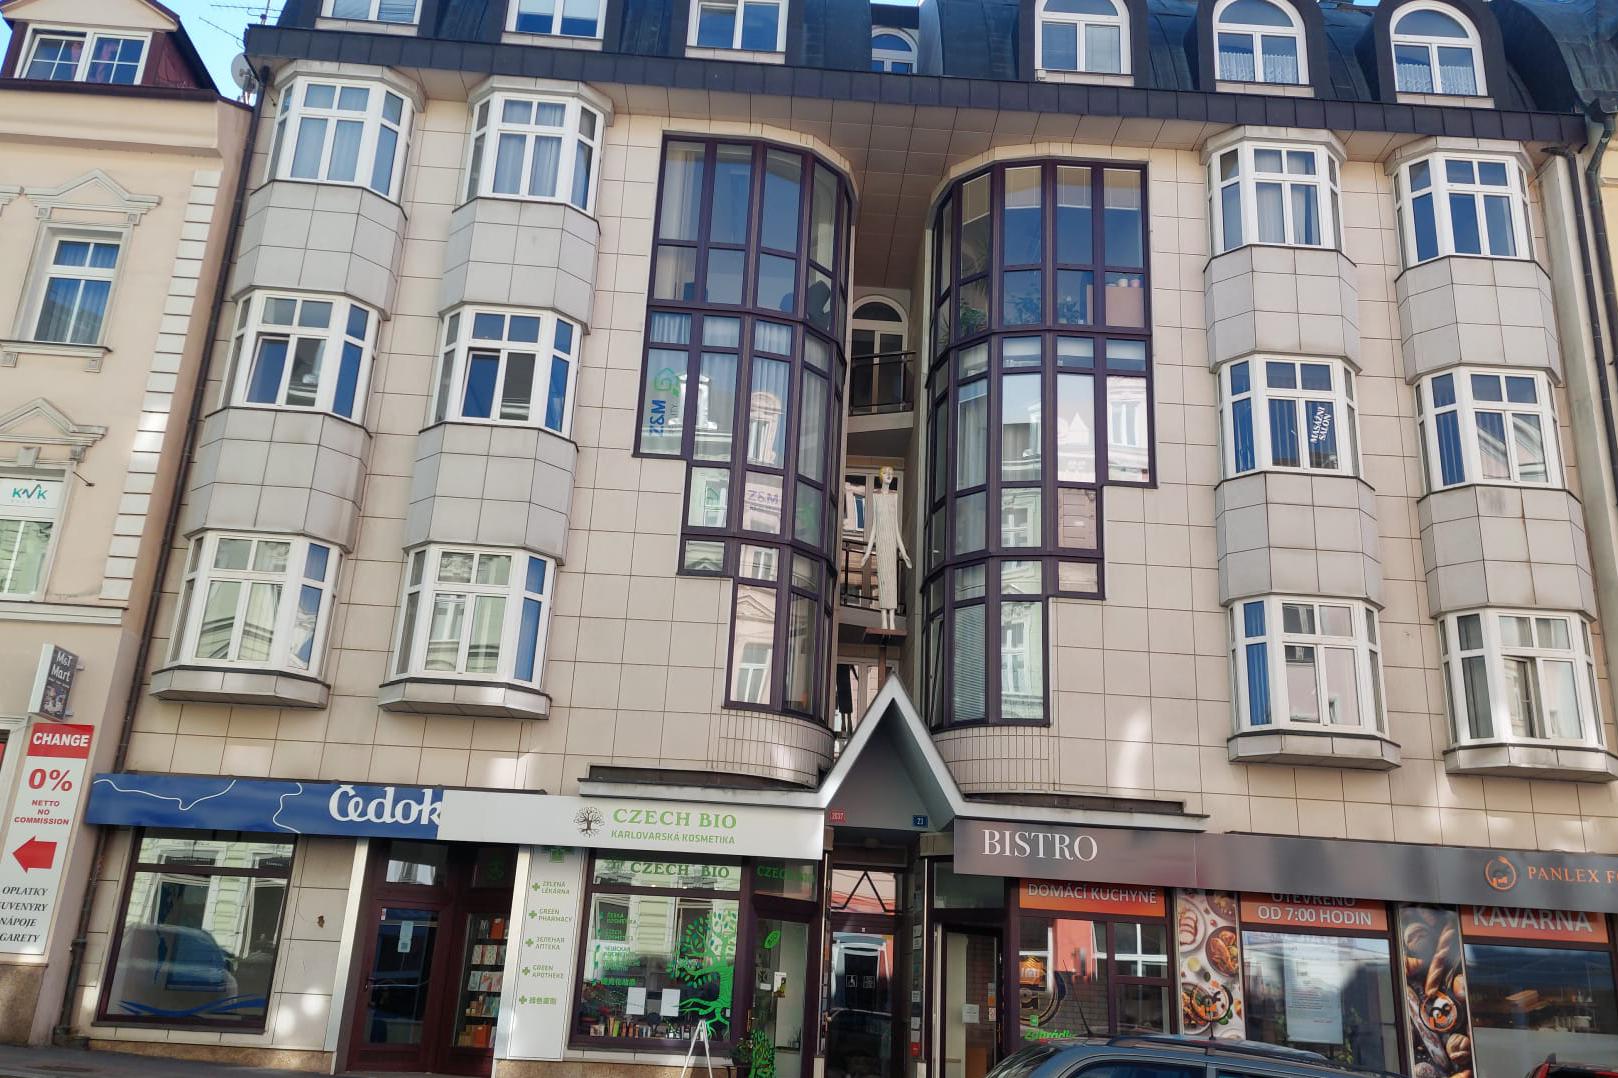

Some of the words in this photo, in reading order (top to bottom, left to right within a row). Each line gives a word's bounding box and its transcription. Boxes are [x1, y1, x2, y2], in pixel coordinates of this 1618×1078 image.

[1319, 413, 1332, 441] SALON
[51, 664, 71, 682] Mart
[32, 733, 90, 747] CHANGE
[28, 768, 73, 792] 0%
[31, 799, 60, 807] NETTO
[328, 784, 441, 825] Čedok
[14, 816, 69, 825] COMMISSION
[613, 808, 692, 827] CZECH
[699, 812, 737, 829] BIO
[682, 833, 736, 844] KOSMETIKA
[982, 829, 1098, 862] BISTRO
[630, 862, 689, 876] CZECH
[701, 865, 730, 879] BIO
[1527, 866, 1600, 884] PANLEX
[2, 886, 49, 896] OPLATKY
[1027, 883, 1087, 899] DOMÁCÍ
[1091, 887, 1157, 904] KUCHYNĚ
[1258, 906, 1282, 920] OD
[1286, 907, 1316, 922] 7:00
[1320, 910, 1372, 925] HODIN
